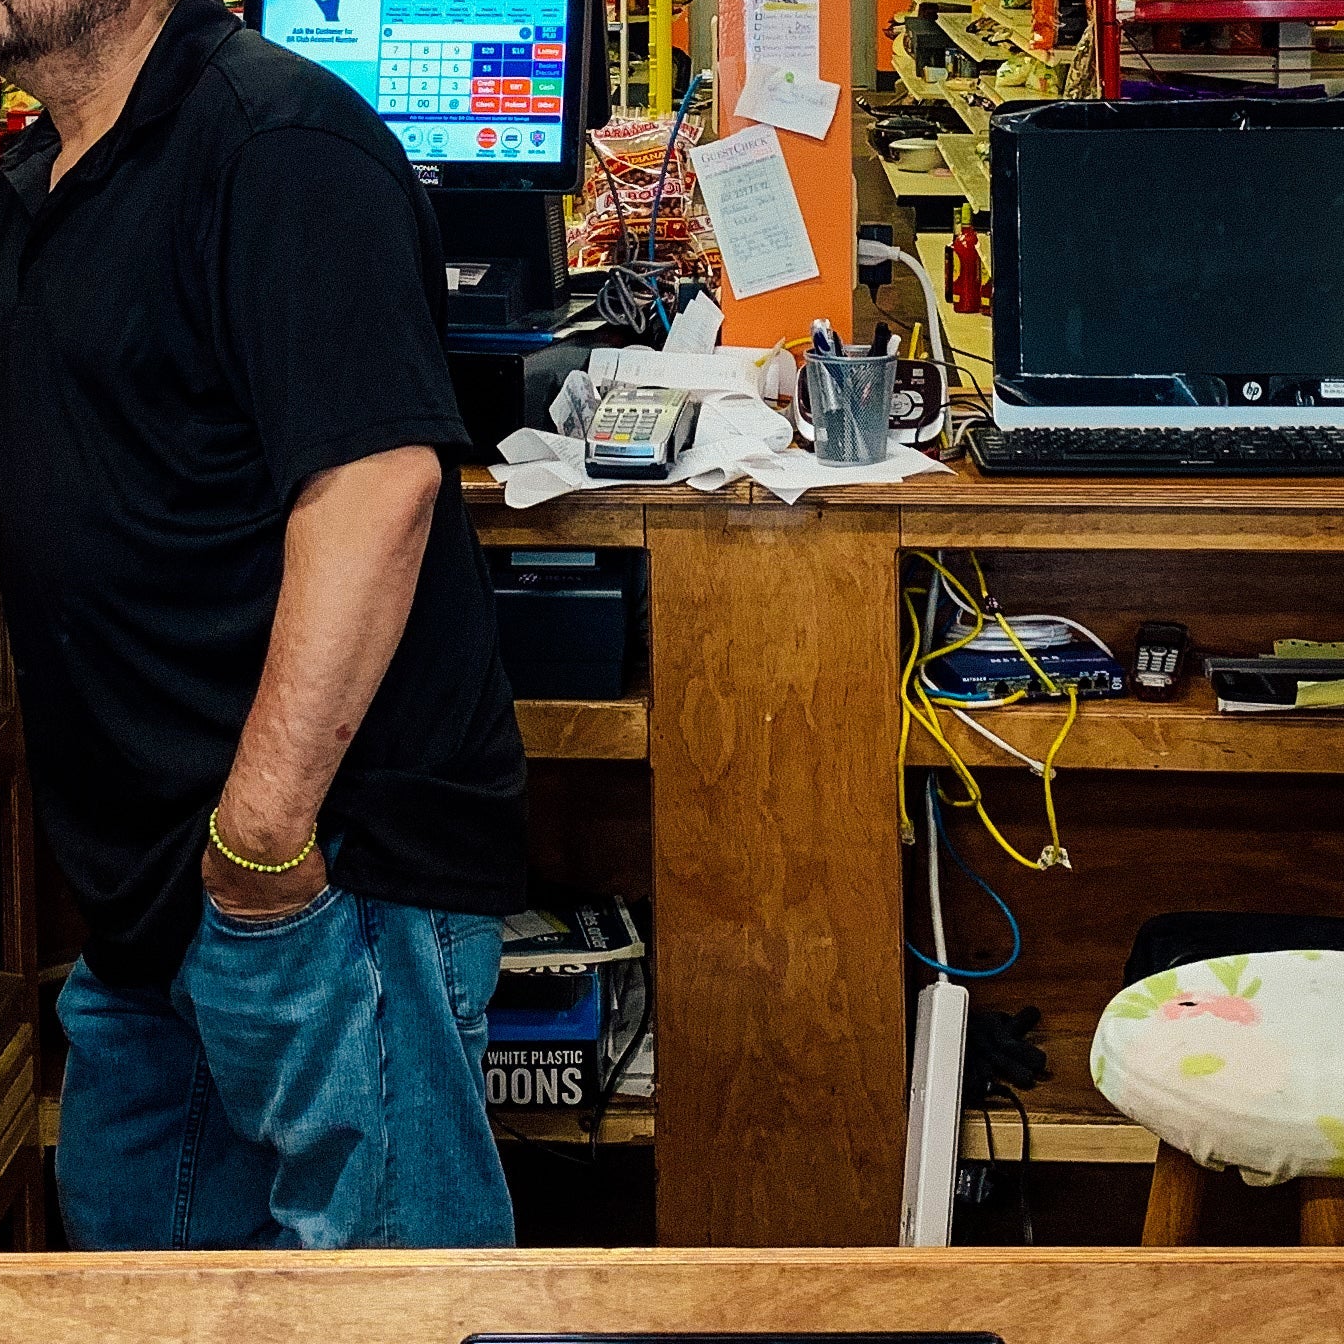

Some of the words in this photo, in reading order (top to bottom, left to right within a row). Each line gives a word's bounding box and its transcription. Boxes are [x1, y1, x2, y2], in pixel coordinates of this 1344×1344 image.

[393, 46, 399, 54] 7
[423, 47, 429, 55] 8
[454, 47, 460, 55] 9
[482, 47, 494, 55] $20
[512, 47, 524, 55] $10
[422, 65, 428, 73] 5
[453, 64, 459, 72] 6
[391, 82, 396, 90] 1
[422, 81, 427, 90] 2
[452, 81, 458, 90] 3
[390, 99, 396, 107] 0
[417, 99, 430, 108] 00
[631, 150, 667, 164] DIANA
[1245, 382, 1260, 400] hp
[487, 1051, 528, 1065] WHITE
[531, 1050, 583, 1065] PLASTIC
[486, 1068, 583, 1105] OONS
